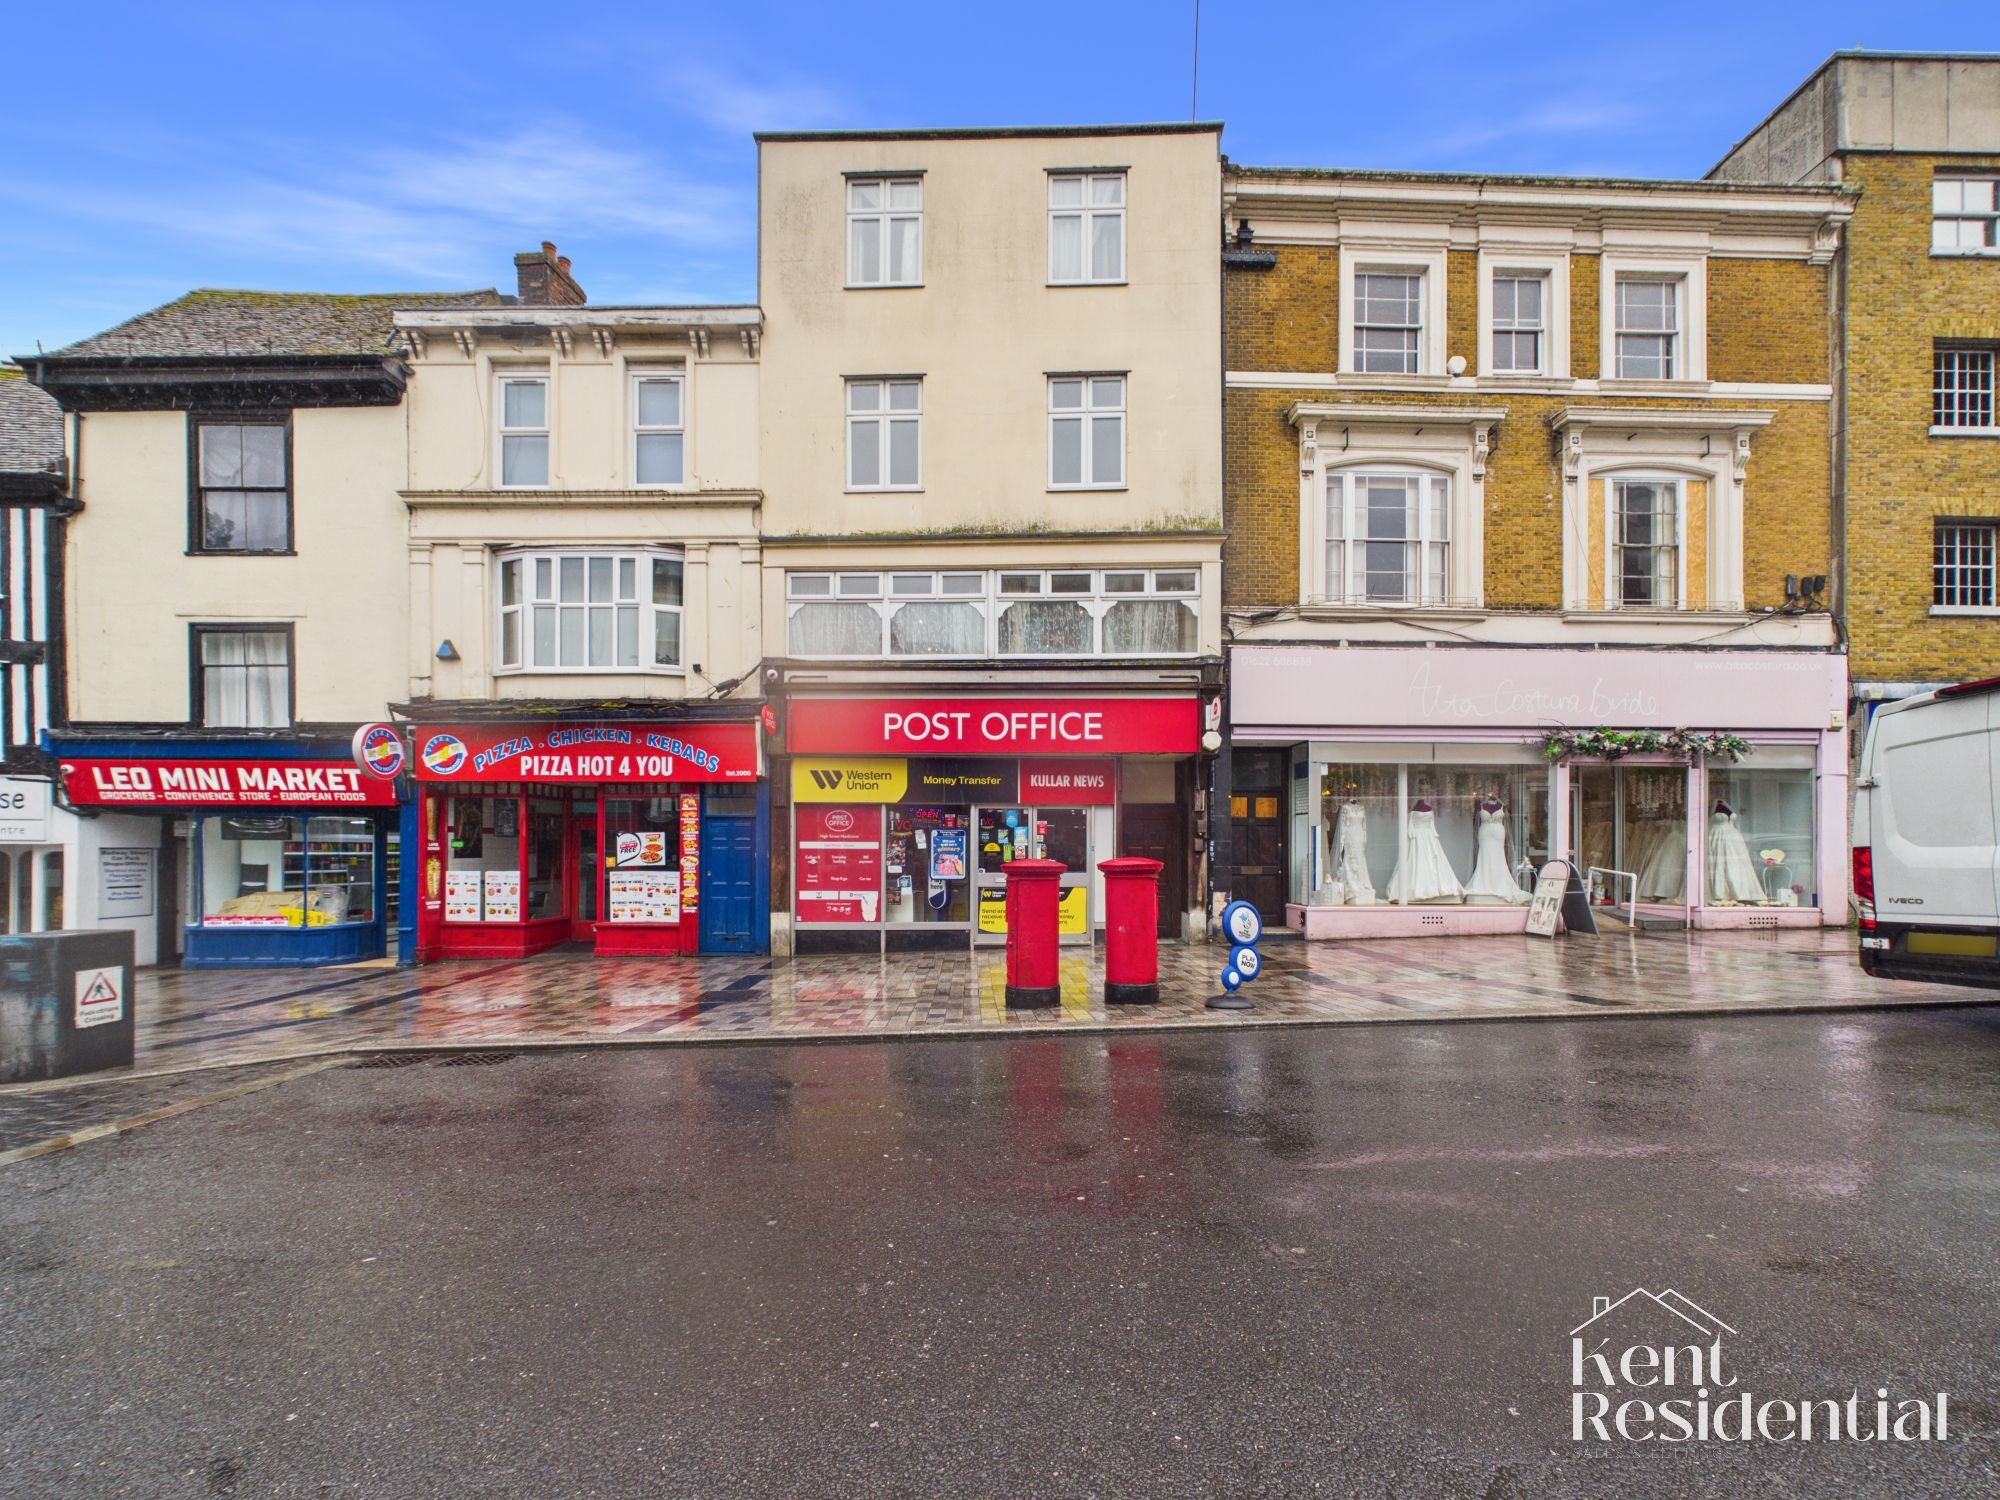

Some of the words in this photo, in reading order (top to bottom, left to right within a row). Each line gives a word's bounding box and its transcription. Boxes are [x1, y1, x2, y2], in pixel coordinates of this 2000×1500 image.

[1494, 679, 1588, 714] Costura
[1591, 677, 1657, 718] Bride
[884, 712, 971, 741] POST
[981, 712, 1104, 741] OFFICE
[473, 736, 534, 773] PIZZA
[547, 728, 631, 748] CHICKEN
[647, 733, 720, 773] KEBABS
[520, 756, 573, 776] PIZZA
[577, 756, 614, 776] HOT
[618, 756, 631, 776] 4
[636, 756, 673, 776] YOU
[92, 767, 153, 790] LEO
[158, 767, 231, 791] MINI
[236, 767, 361, 791] MARKET
[846, 770, 892, 780] Western
[923, 775, 957, 786] Money
[958, 775, 1001, 785] Transfer
[1030, 775, 1070, 787] KULLAR
[1073, 775, 1104, 788] NEWS
[846, 781, 879, 790] Union
[99, 791, 156, 800] GROCERIES
[165, 792, 236, 801] CONVENIENCE
[239, 792, 271, 801] STORE
[280, 792, 332, 801] EUROPEAN
[334, 792, 367, 801] FOODS
[1241, 960, 1255, 969] NOW
